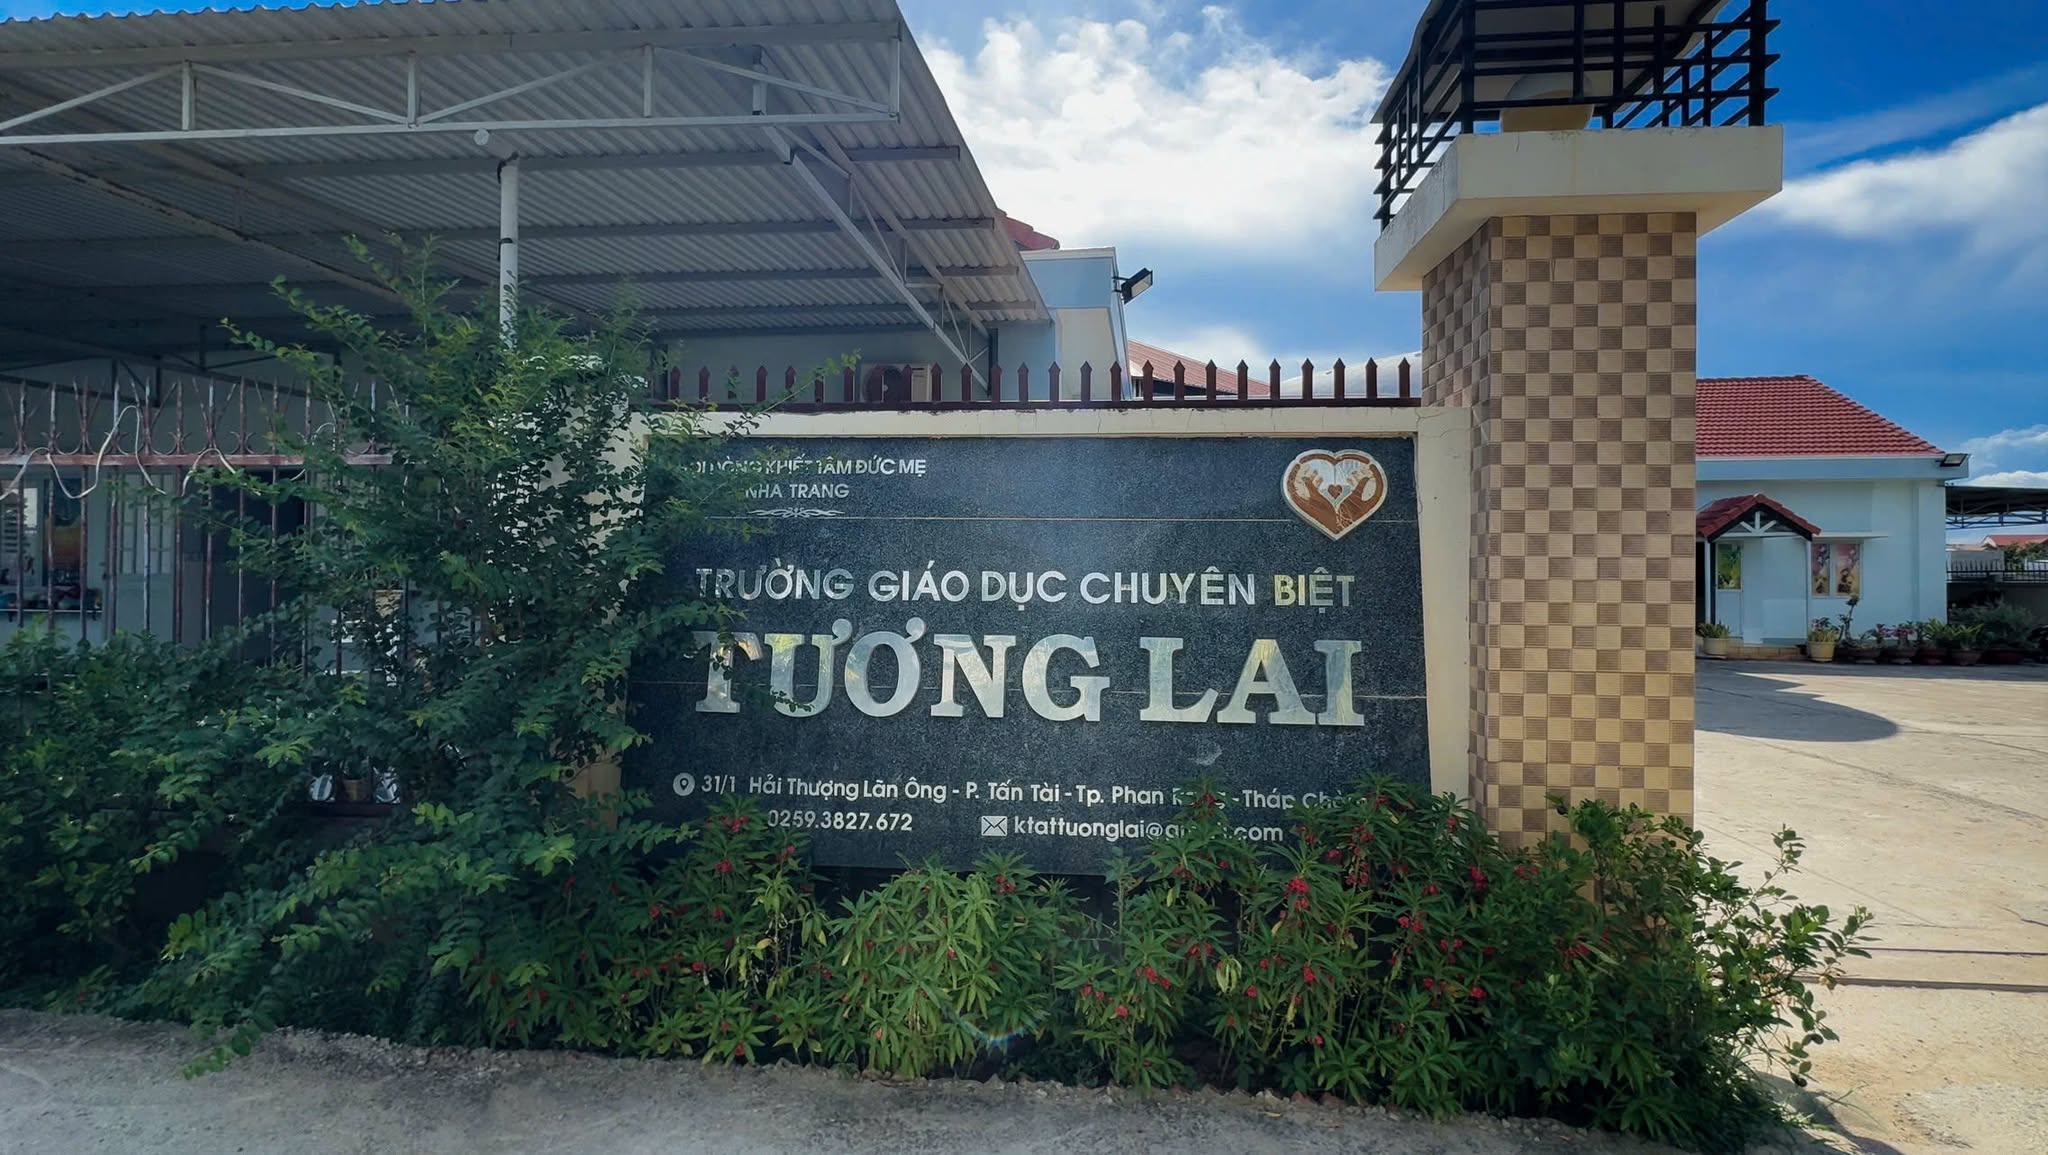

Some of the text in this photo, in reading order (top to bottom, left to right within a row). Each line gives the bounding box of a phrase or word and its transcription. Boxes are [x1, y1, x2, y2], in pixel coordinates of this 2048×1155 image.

[855, 455, 896, 475] ĐỨC
[899, 459, 926, 477] MẸ
[745, 483, 850, 498] NHA TRANG
[696, 558, 1355, 613] TRƯỜNG GIÁO DỤC CHUYÊN BIỆT
[690, 617, 1365, 726] TƯƠNG LAI
[701, 774, 736, 795] 31/1
[749, 773, 782, 795] Hải
[787, 777, 859, 801] Thượng
[863, 779, 899, 798] Lãn
[904, 776, 947, 803] Ông
[966, 781, 979, 800] P.
[988, 779, 1023, 801] Tấn
[1031, 783, 1060, 802] Tài
[1075, 784, 1104, 807] Tp.
[1112, 785, 1164, 805] Phan
[1242, 787, 1296, 810] Tháp
[768, 809, 913, 831] 0259.3827.672
